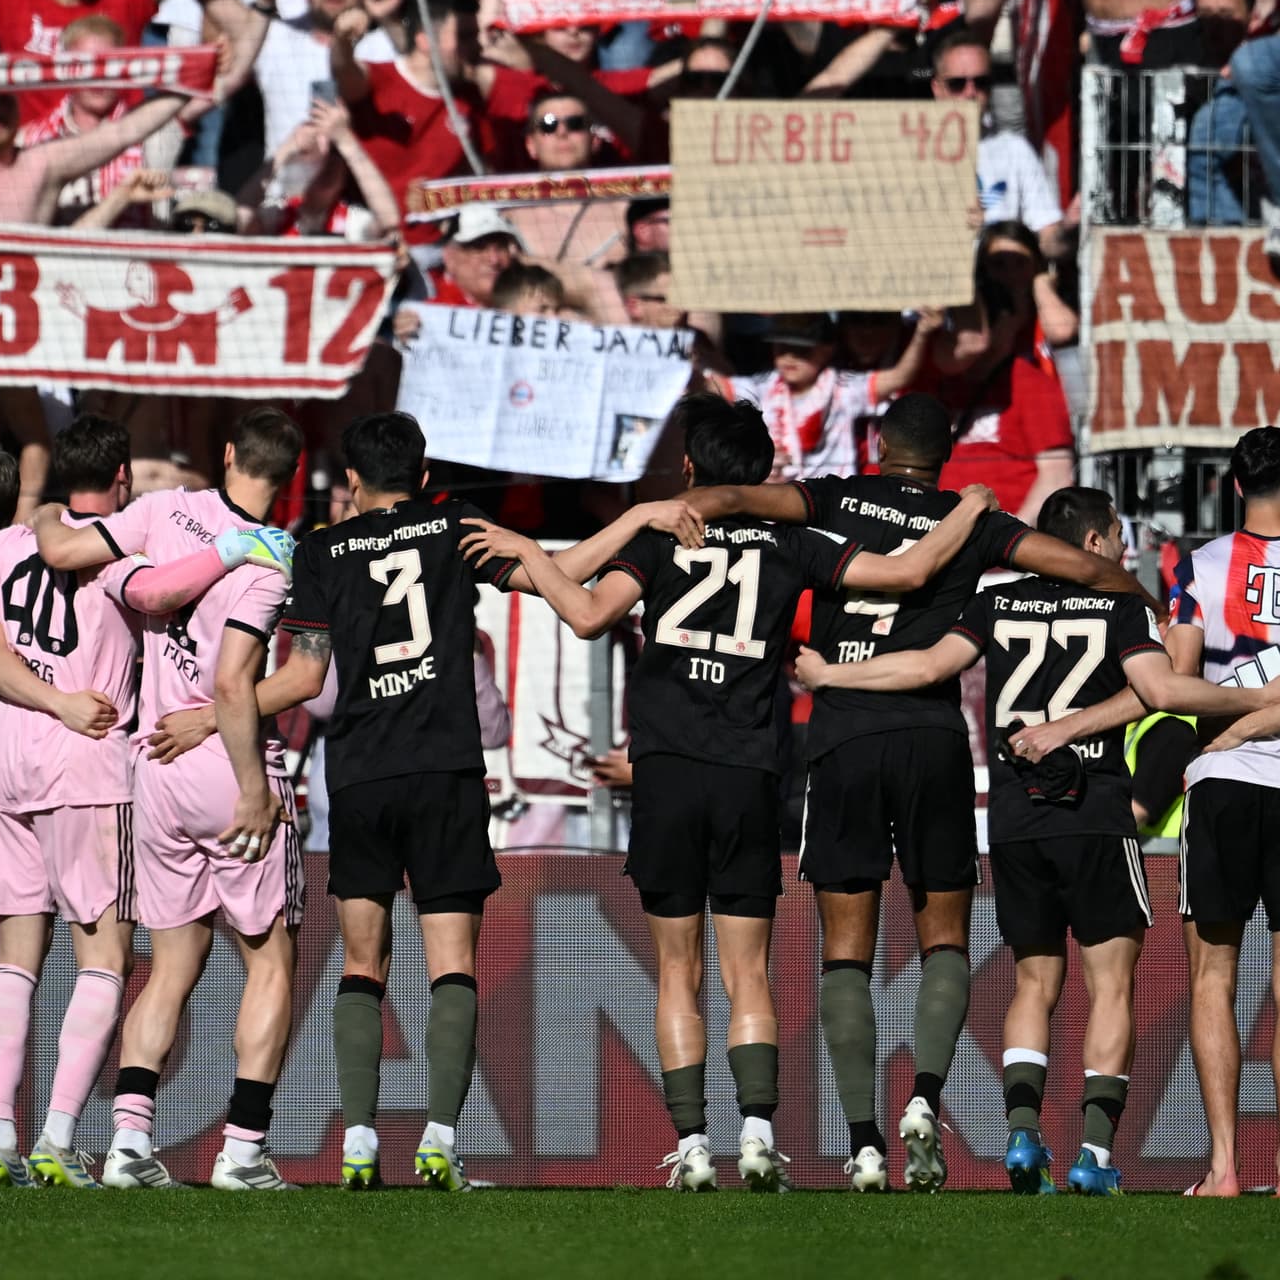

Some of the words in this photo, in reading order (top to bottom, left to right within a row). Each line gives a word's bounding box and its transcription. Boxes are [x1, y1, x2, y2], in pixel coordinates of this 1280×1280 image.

[710, 111, 858, 167] URBIG
[900, 111, 968, 165] 40
[269, 263, 388, 366] 12
[447, 309, 572, 350] LIEBER
[839, 496, 858, 514] FC
[858, 503, 907, 526] BAYERN
[329, 544, 346, 559] FC
[348, 534, 393, 553] BAYERN
[1, 552, 80, 658] 40
[655, 546, 767, 660] 21
[993, 595, 1009, 611] FC
[1010, 599, 1058, 615] BAYERN
[688, 656, 727, 685] ITO
[837, 640, 876, 663] TAH
[993, 618, 1109, 728] 22
